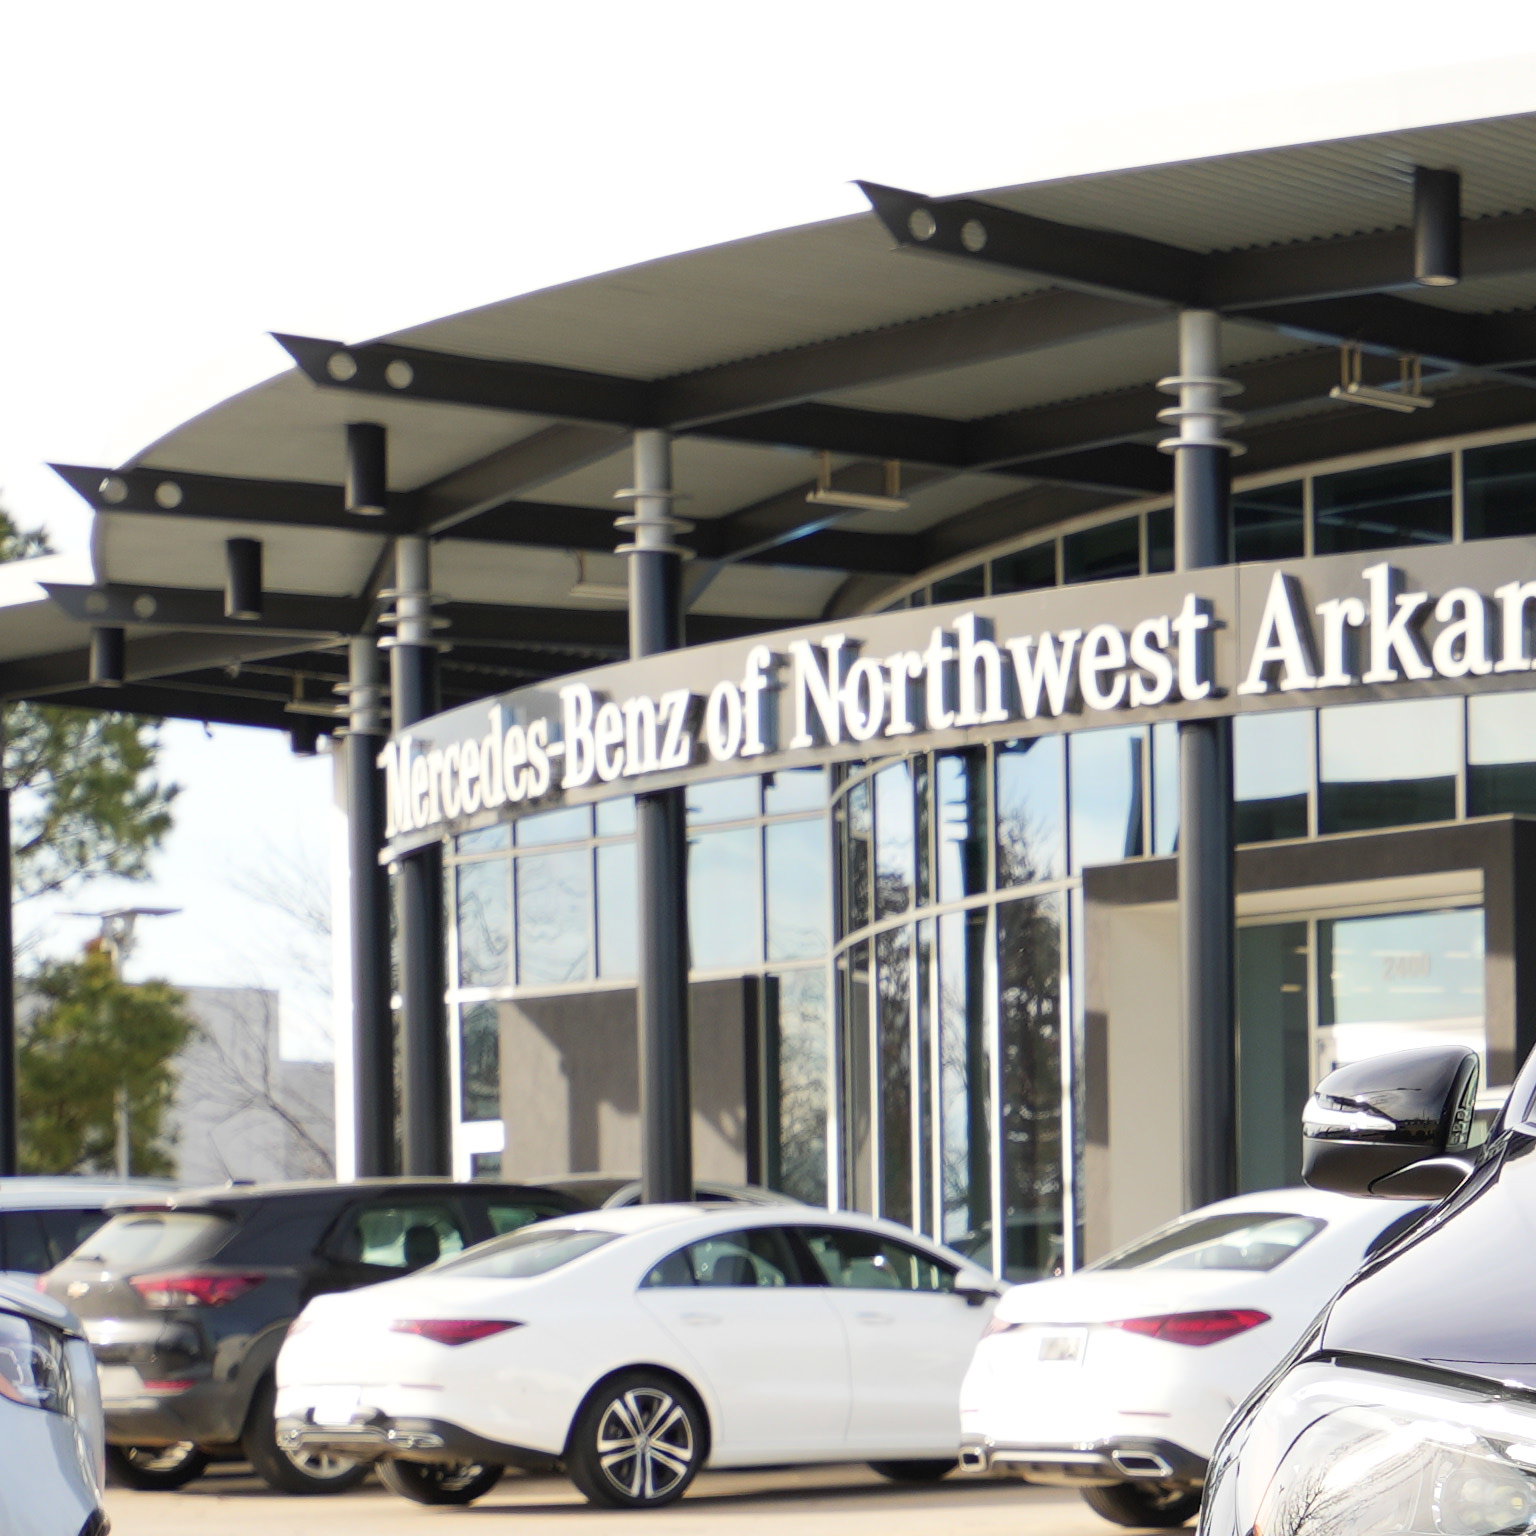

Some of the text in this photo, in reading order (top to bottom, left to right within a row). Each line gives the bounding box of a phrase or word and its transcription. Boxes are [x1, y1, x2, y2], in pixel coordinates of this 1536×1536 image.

[377, 682, 691, 838] Mercedes-Benz
[705, 646, 771, 761] of
[789, 593, 1211, 748] Northwest
